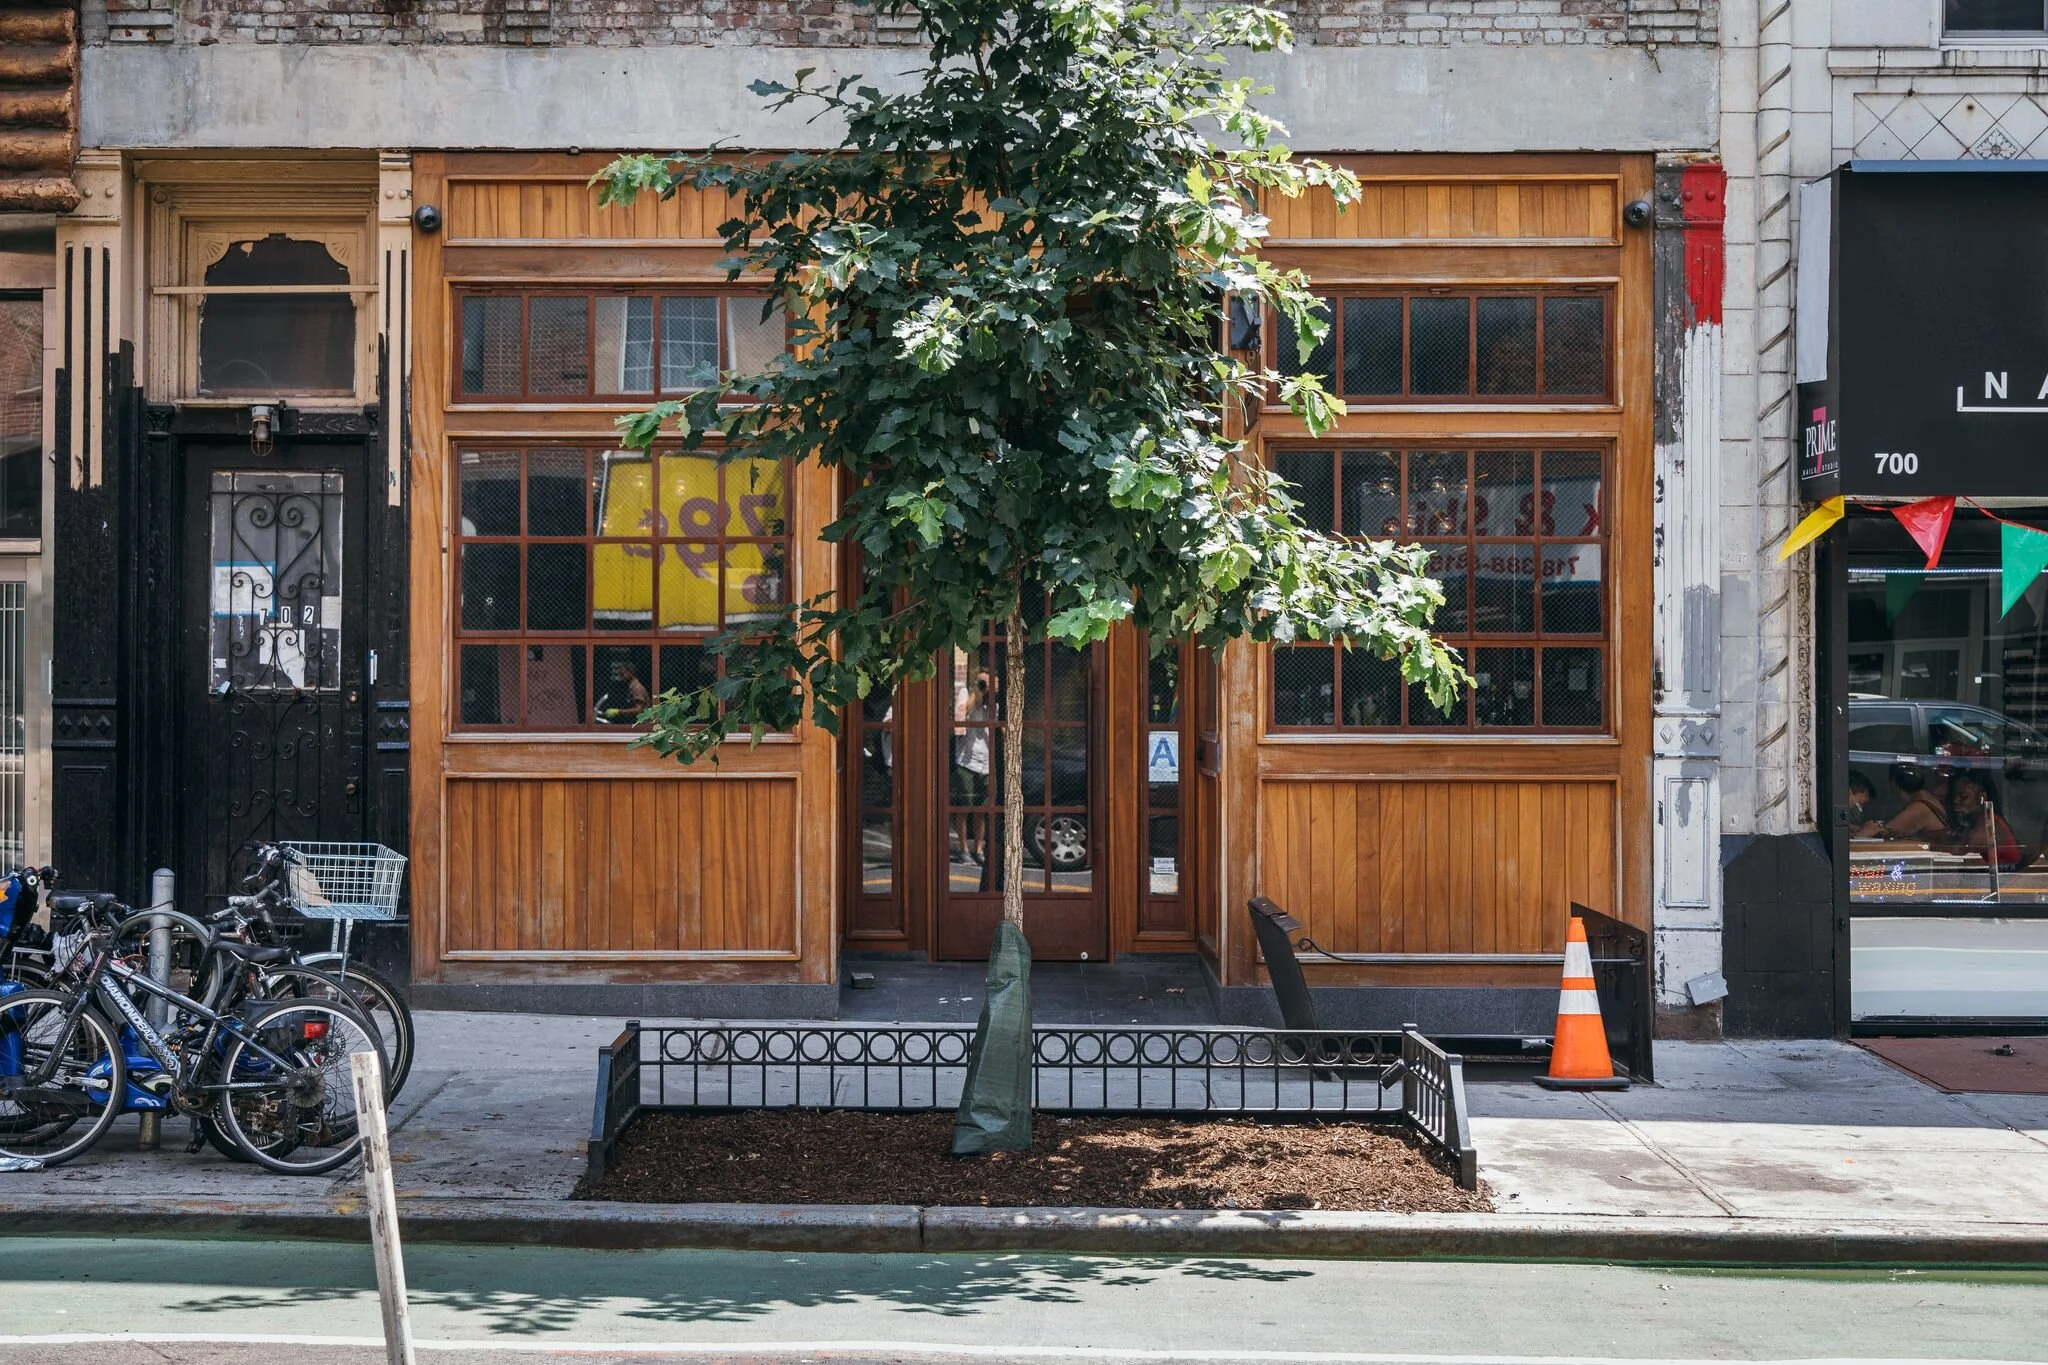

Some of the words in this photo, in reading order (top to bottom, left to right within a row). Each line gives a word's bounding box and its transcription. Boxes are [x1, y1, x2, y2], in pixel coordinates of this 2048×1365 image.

[1805, 420, 1836, 458] PRIME
[1874, 452, 1919, 475] 700
[260, 606, 314, 625] 702
[1149, 737, 1177, 767] A
